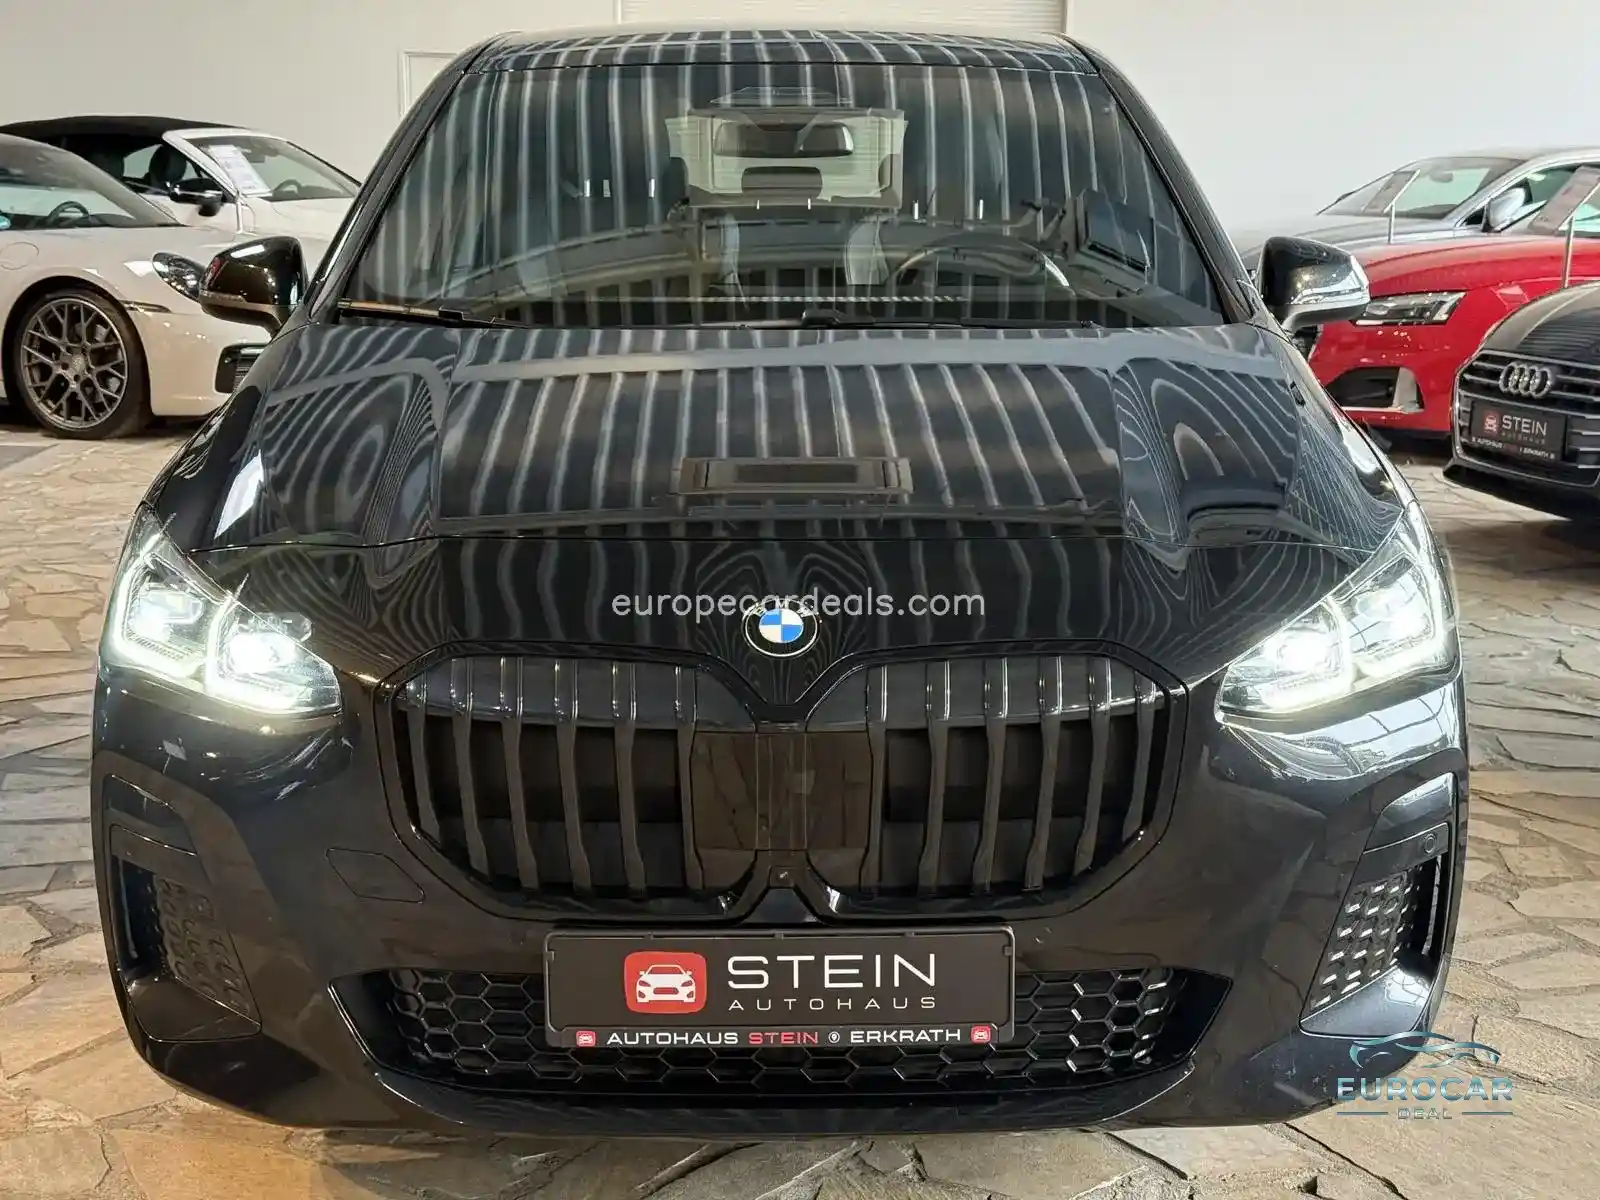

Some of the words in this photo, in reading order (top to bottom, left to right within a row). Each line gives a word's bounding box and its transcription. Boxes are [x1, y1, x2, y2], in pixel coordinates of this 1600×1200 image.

[1502, 415, 1548, 436] STEIN
[727, 954, 936, 989] STEIN
[728, 996, 936, 1011] AUTOHAUS
[606, 1032, 738, 1045] AUTOHAUS
[748, 1031, 818, 1044] STEIN
[850, 1029, 961, 1043] ERKRATH
